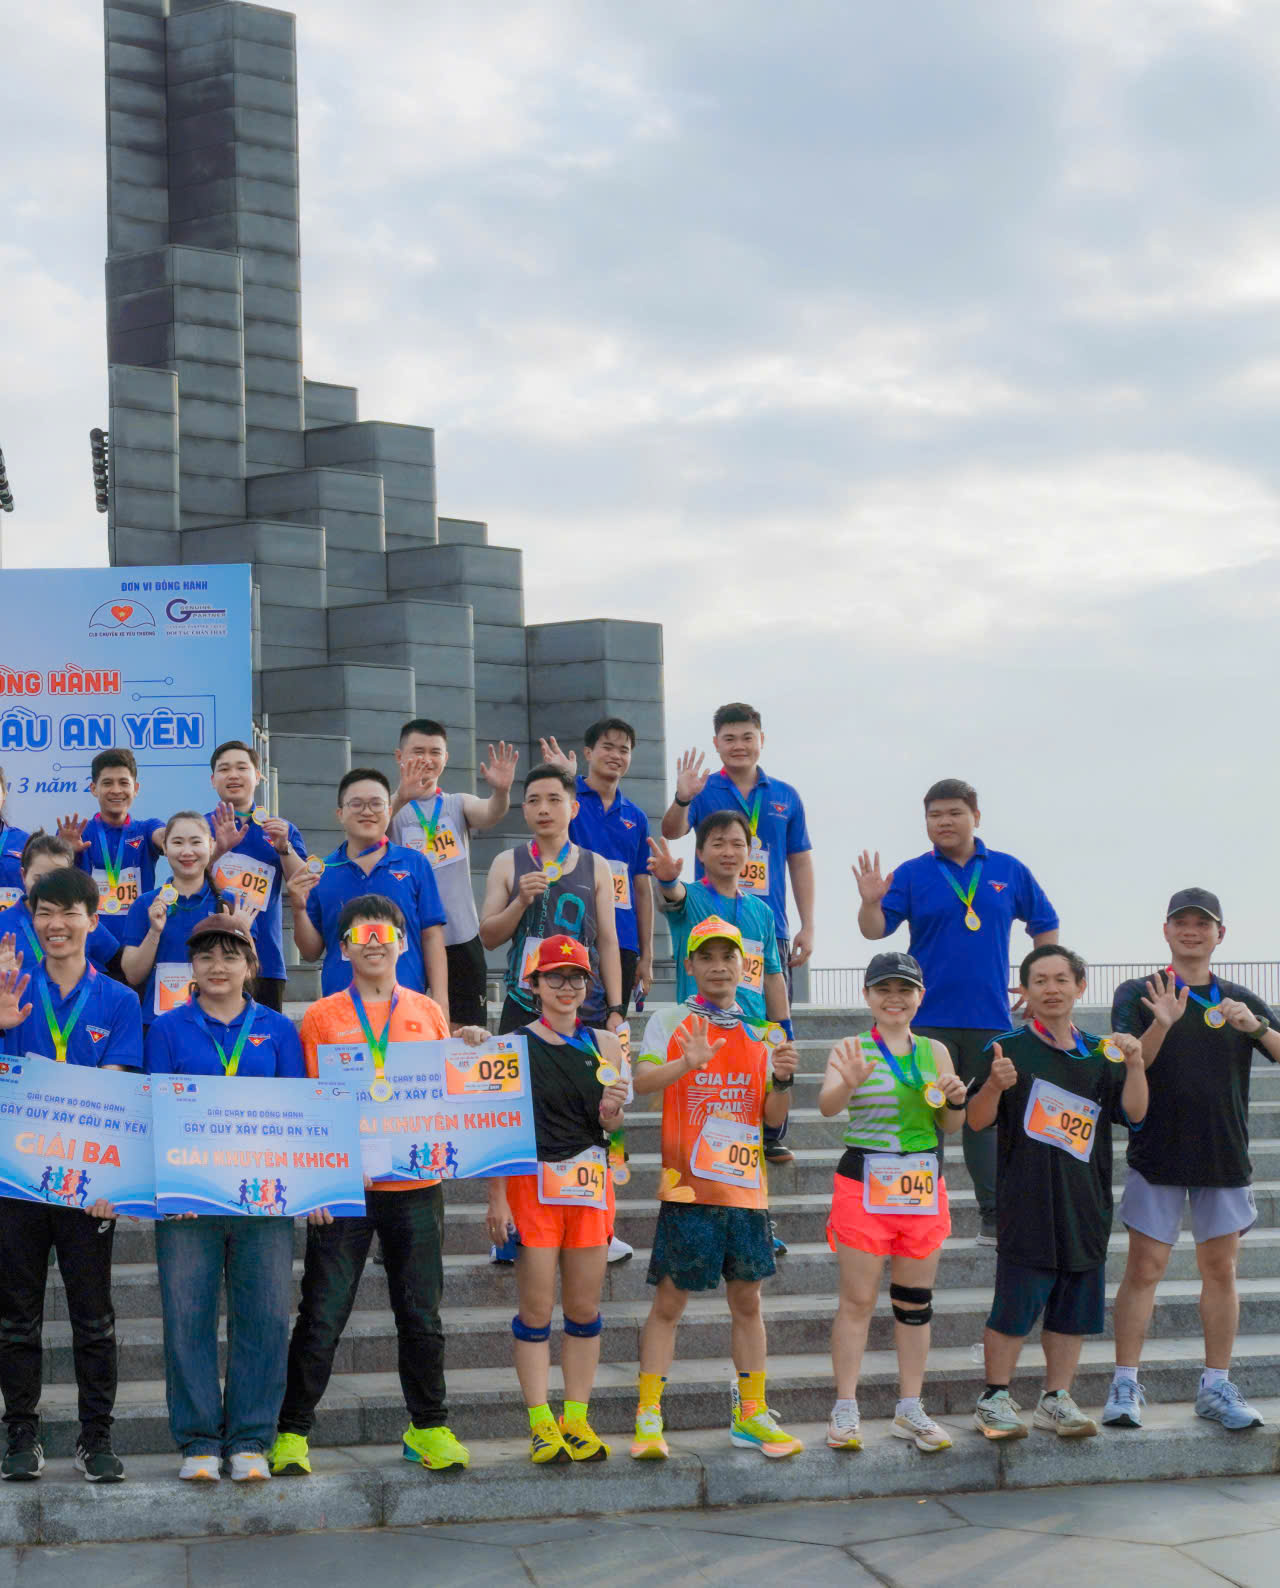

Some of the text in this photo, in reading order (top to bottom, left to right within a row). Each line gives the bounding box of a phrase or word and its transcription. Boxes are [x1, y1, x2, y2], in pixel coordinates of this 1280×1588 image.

[48, 663, 121, 695] HÀNH
[60, 714, 115, 750] AN
[123, 707, 204, 749] YÊN
[17, 777, 30, 793] 3
[35, 777, 77, 793] năm
[116, 885, 138, 901] 015
[241, 872, 268, 895] 012
[478, 1058, 519, 1080] 025
[695, 1072, 752, 1086] GIA LAI
[720, 1088, 747, 1100] CITY
[706, 1101, 743, 1114] TRAIL
[104, 1119, 121, 1130] AN
[287, 1125, 303, 1136] AN
[1060, 1112, 1093, 1142] 020
[14, 1131, 121, 1168] GIẢI BA
[729, 1144, 759, 1168] 003
[577, 1166, 605, 1190] 041
[900, 1174, 934, 1196] 040
